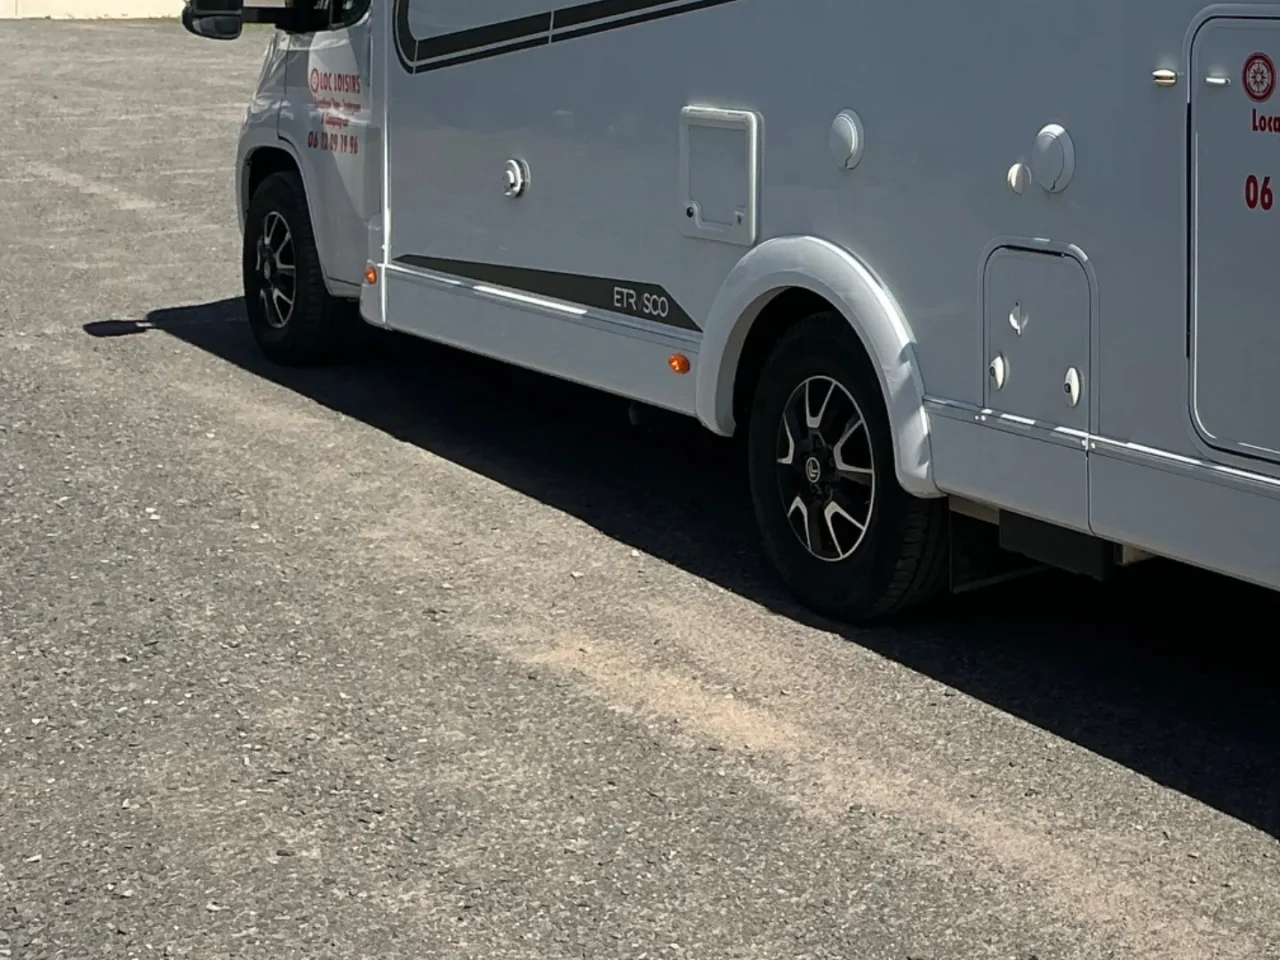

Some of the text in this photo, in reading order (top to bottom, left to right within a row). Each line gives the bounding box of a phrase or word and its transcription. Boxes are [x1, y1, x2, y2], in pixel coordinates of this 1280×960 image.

[320, 72, 360, 94] LOC LOISIRS
[1245, 174, 1273, 211] 06
